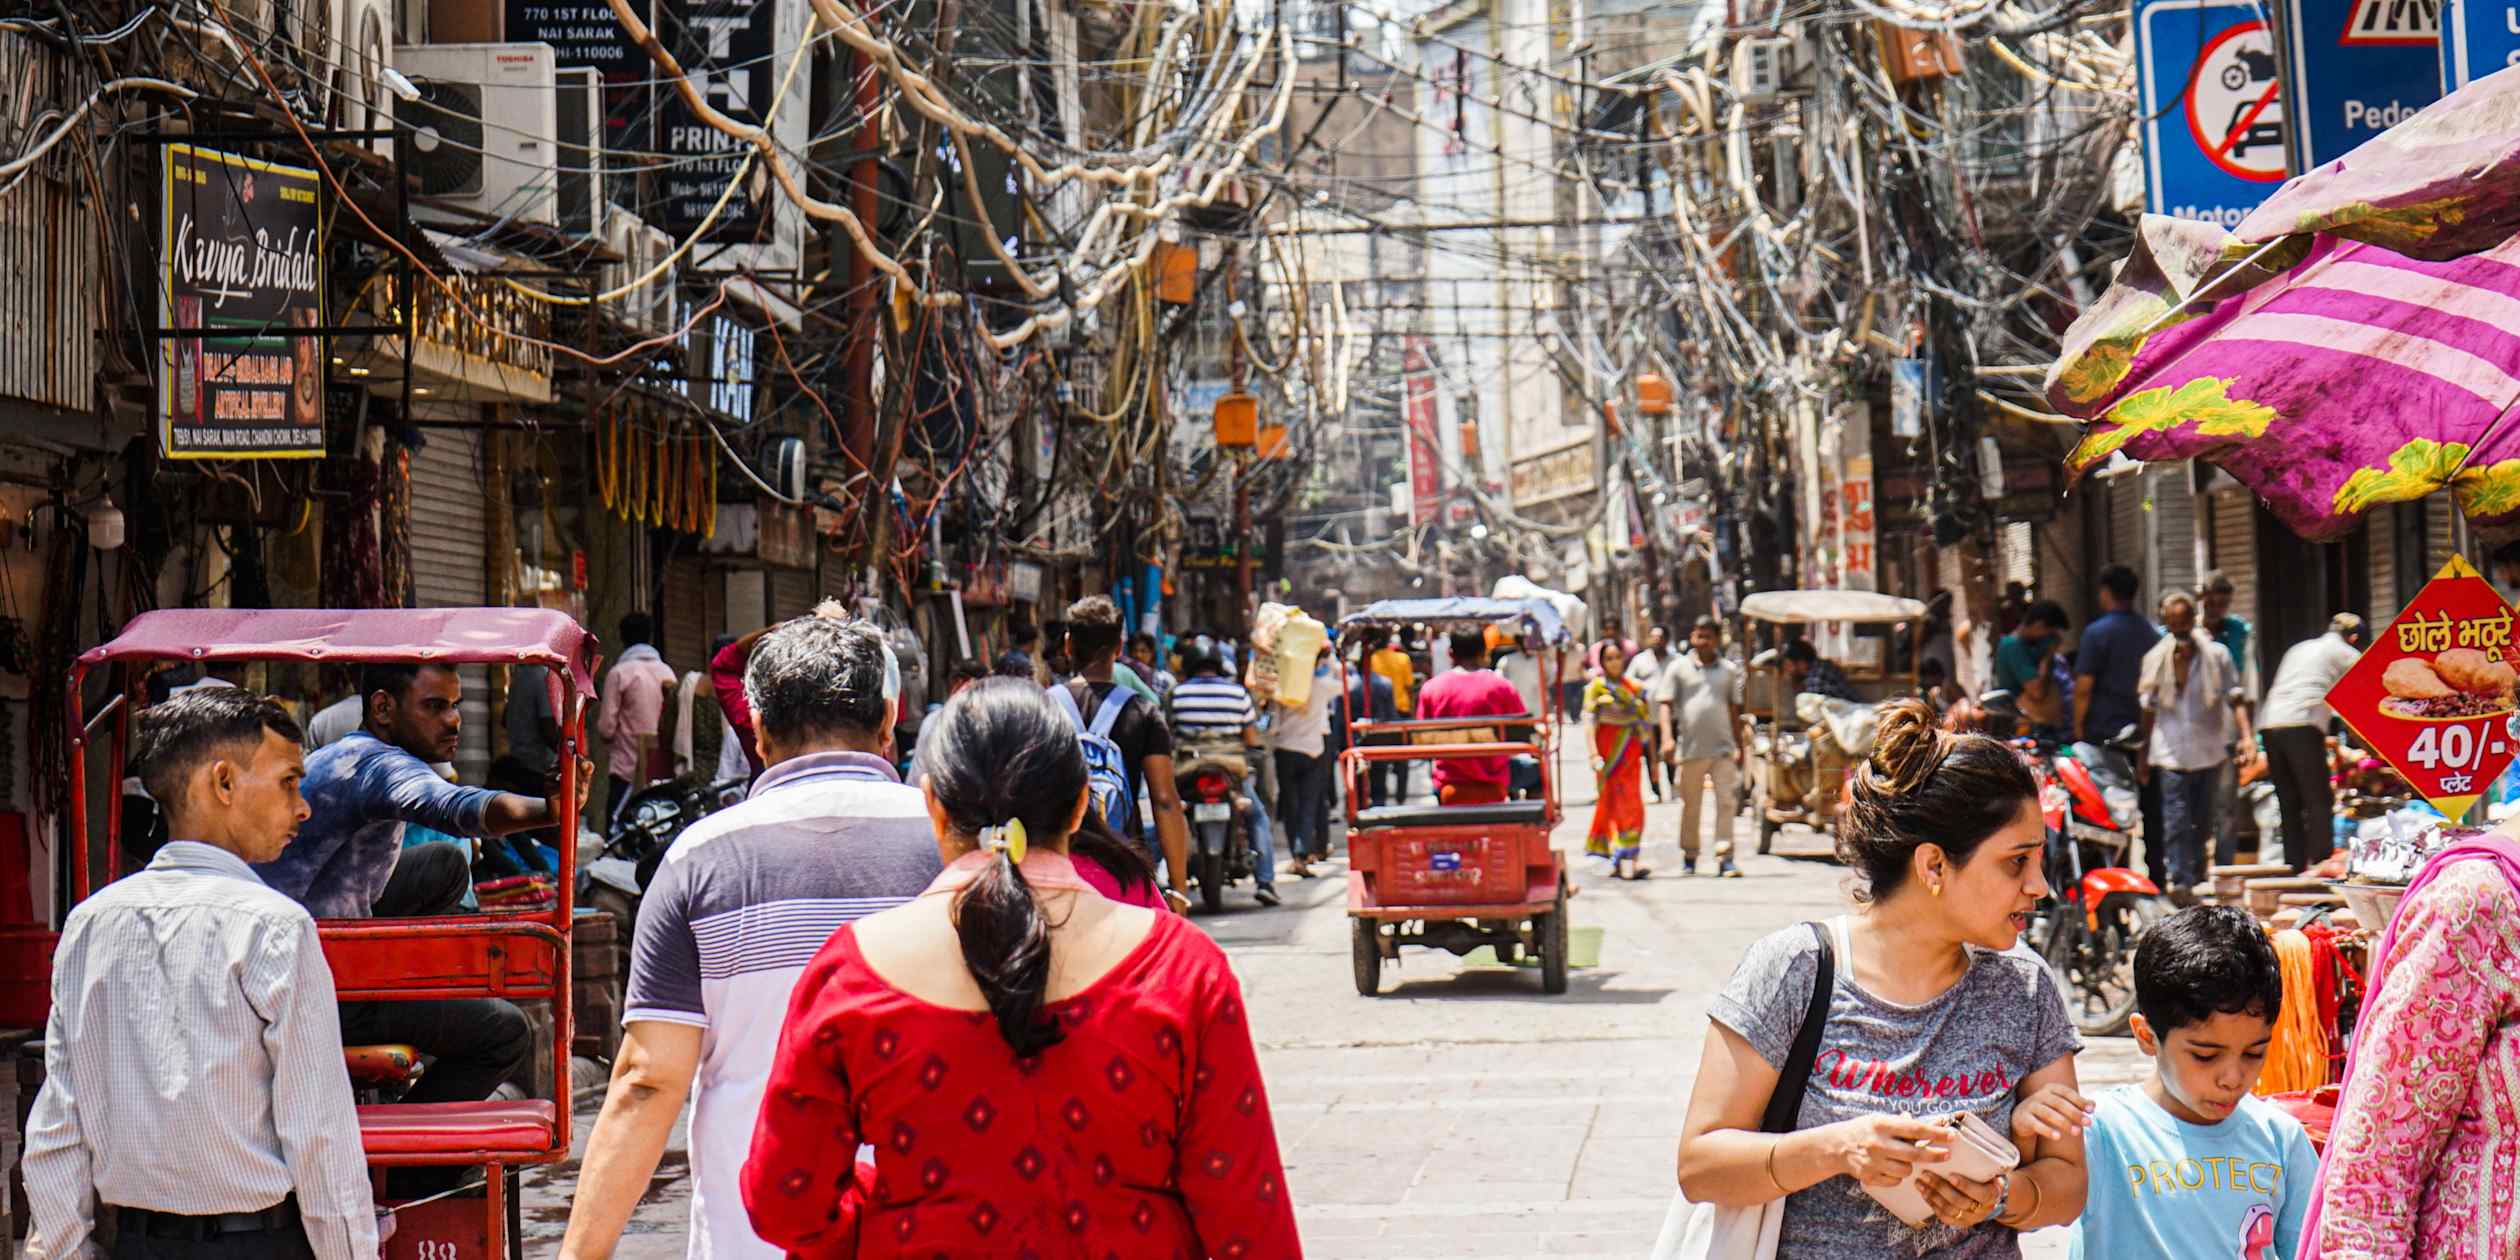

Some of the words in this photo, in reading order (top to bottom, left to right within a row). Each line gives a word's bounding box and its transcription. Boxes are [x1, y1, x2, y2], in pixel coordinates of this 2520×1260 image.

[523, 7, 549, 20] 770
[553, 7, 578, 21] 1ST
[537, 26, 562, 40] NAI
[566, 26, 615, 40] SARAK
[554, 46, 624, 60] HI-110006
[2344, 99, 2424, 129] Pede
[249, 225, 317, 293] Bridals
[2397, 609, 2454, 652] छोले
[2458, 606, 2513, 662] भठूरे
[2408, 721, 2505, 770] 40/-
[2440, 771, 2472, 793] प्लेट
[1814, 1048, 2015, 1099] Wherever
[1887, 1099, 1921, 1115] YOU
[1927, 1100, 1953, 1114] GO
[2127, 1156, 2283, 1199] PROTECT
